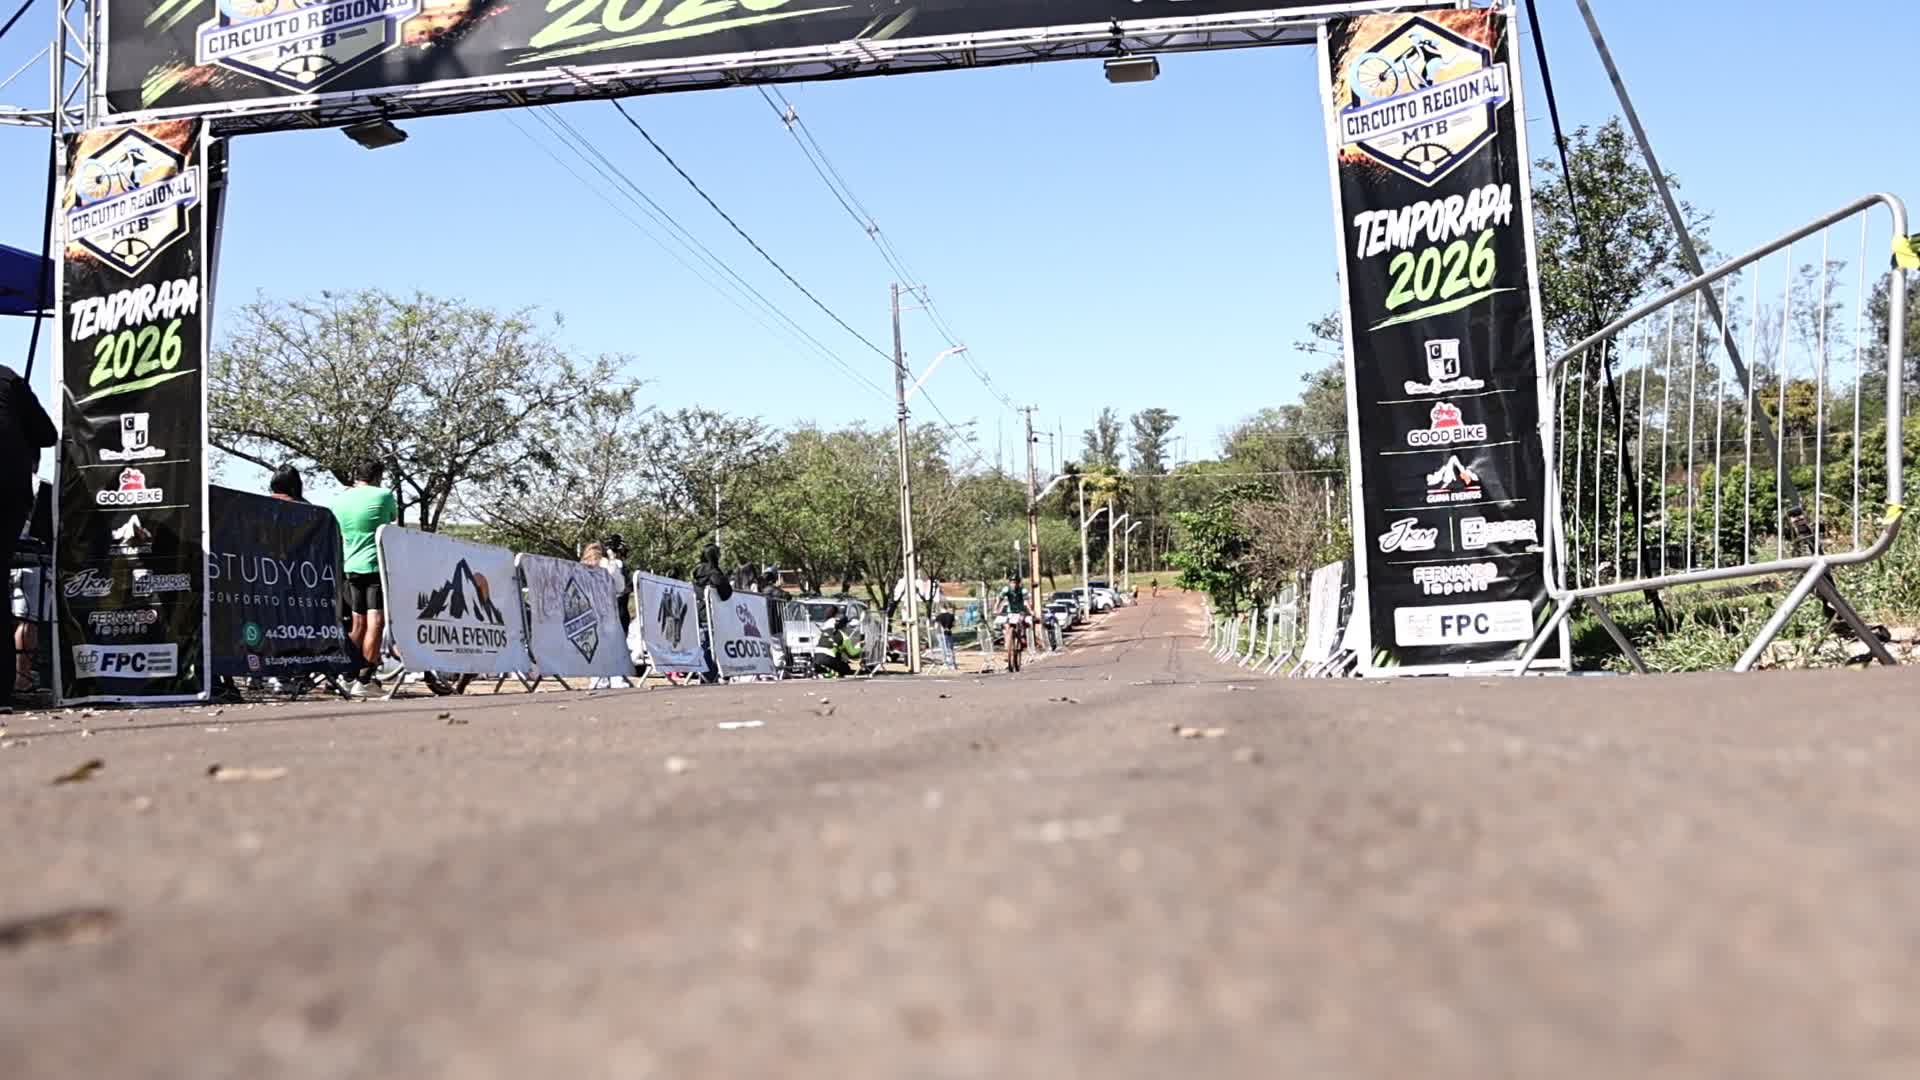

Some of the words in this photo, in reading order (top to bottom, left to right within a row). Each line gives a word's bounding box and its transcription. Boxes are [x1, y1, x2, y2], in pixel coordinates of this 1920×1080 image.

[209, 18, 300, 53] CIRCUITO
[308, 0, 408, 28] REGIONAL
[278, 33, 337, 58] MTB
[1347, 100, 1418, 136] CIRCUITO
[1423, 74, 1500, 120] REGIONAL
[1402, 119, 1449, 146] MTB
[71, 198, 127, 237] CIRCUITO
[129, 178, 194, 217] REGIONAL
[111, 217, 151, 240] MTB
[1353, 184, 1513, 260] TEMPORADA
[1384, 228, 1496, 312] 2026
[70, 277, 199, 342] TEMPORADA
[88, 318, 182, 388] 2026
[1410, 429, 1450, 444] GOOD
[1453, 426, 1485, 441] BIKE
[98, 491, 135, 503] GOOD
[137, 490, 162, 502] BIKE
[1382, 519, 1436, 551] JKM
[1414, 563, 1498, 583] FERNANDO
[209, 592, 280, 607] CONFORTO
[417, 624, 460, 646] GUINA
[462, 627, 508, 648] EVENTOS
[1440, 612, 1490, 637] FPC
[724, 639, 760, 658] GOOD
[100, 652, 147, 673] FPC
